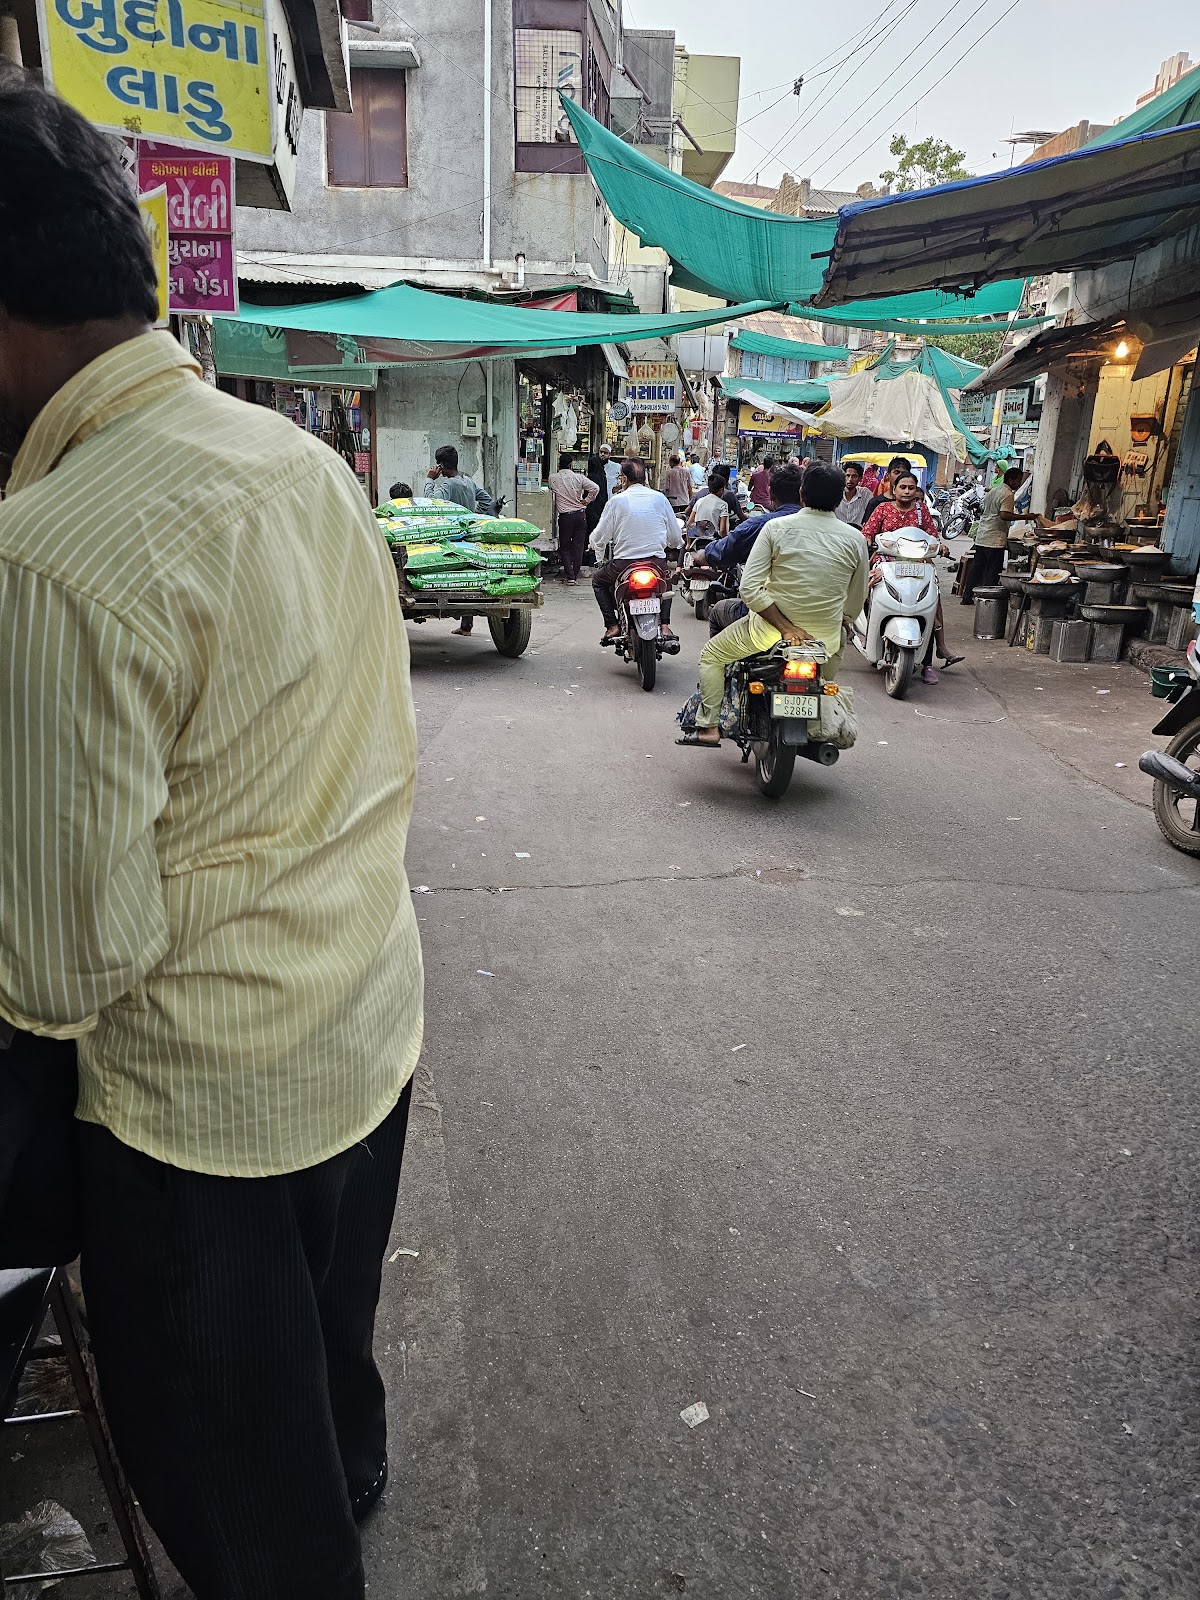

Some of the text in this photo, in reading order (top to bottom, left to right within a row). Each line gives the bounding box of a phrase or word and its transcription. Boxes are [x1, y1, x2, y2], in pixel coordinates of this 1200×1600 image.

[105, 65, 233, 142] લાડુ
[166, 177, 227, 229] લેબી
[784, 696, 813, 706] GJ07C
[784, 706, 813, 716] S2856
